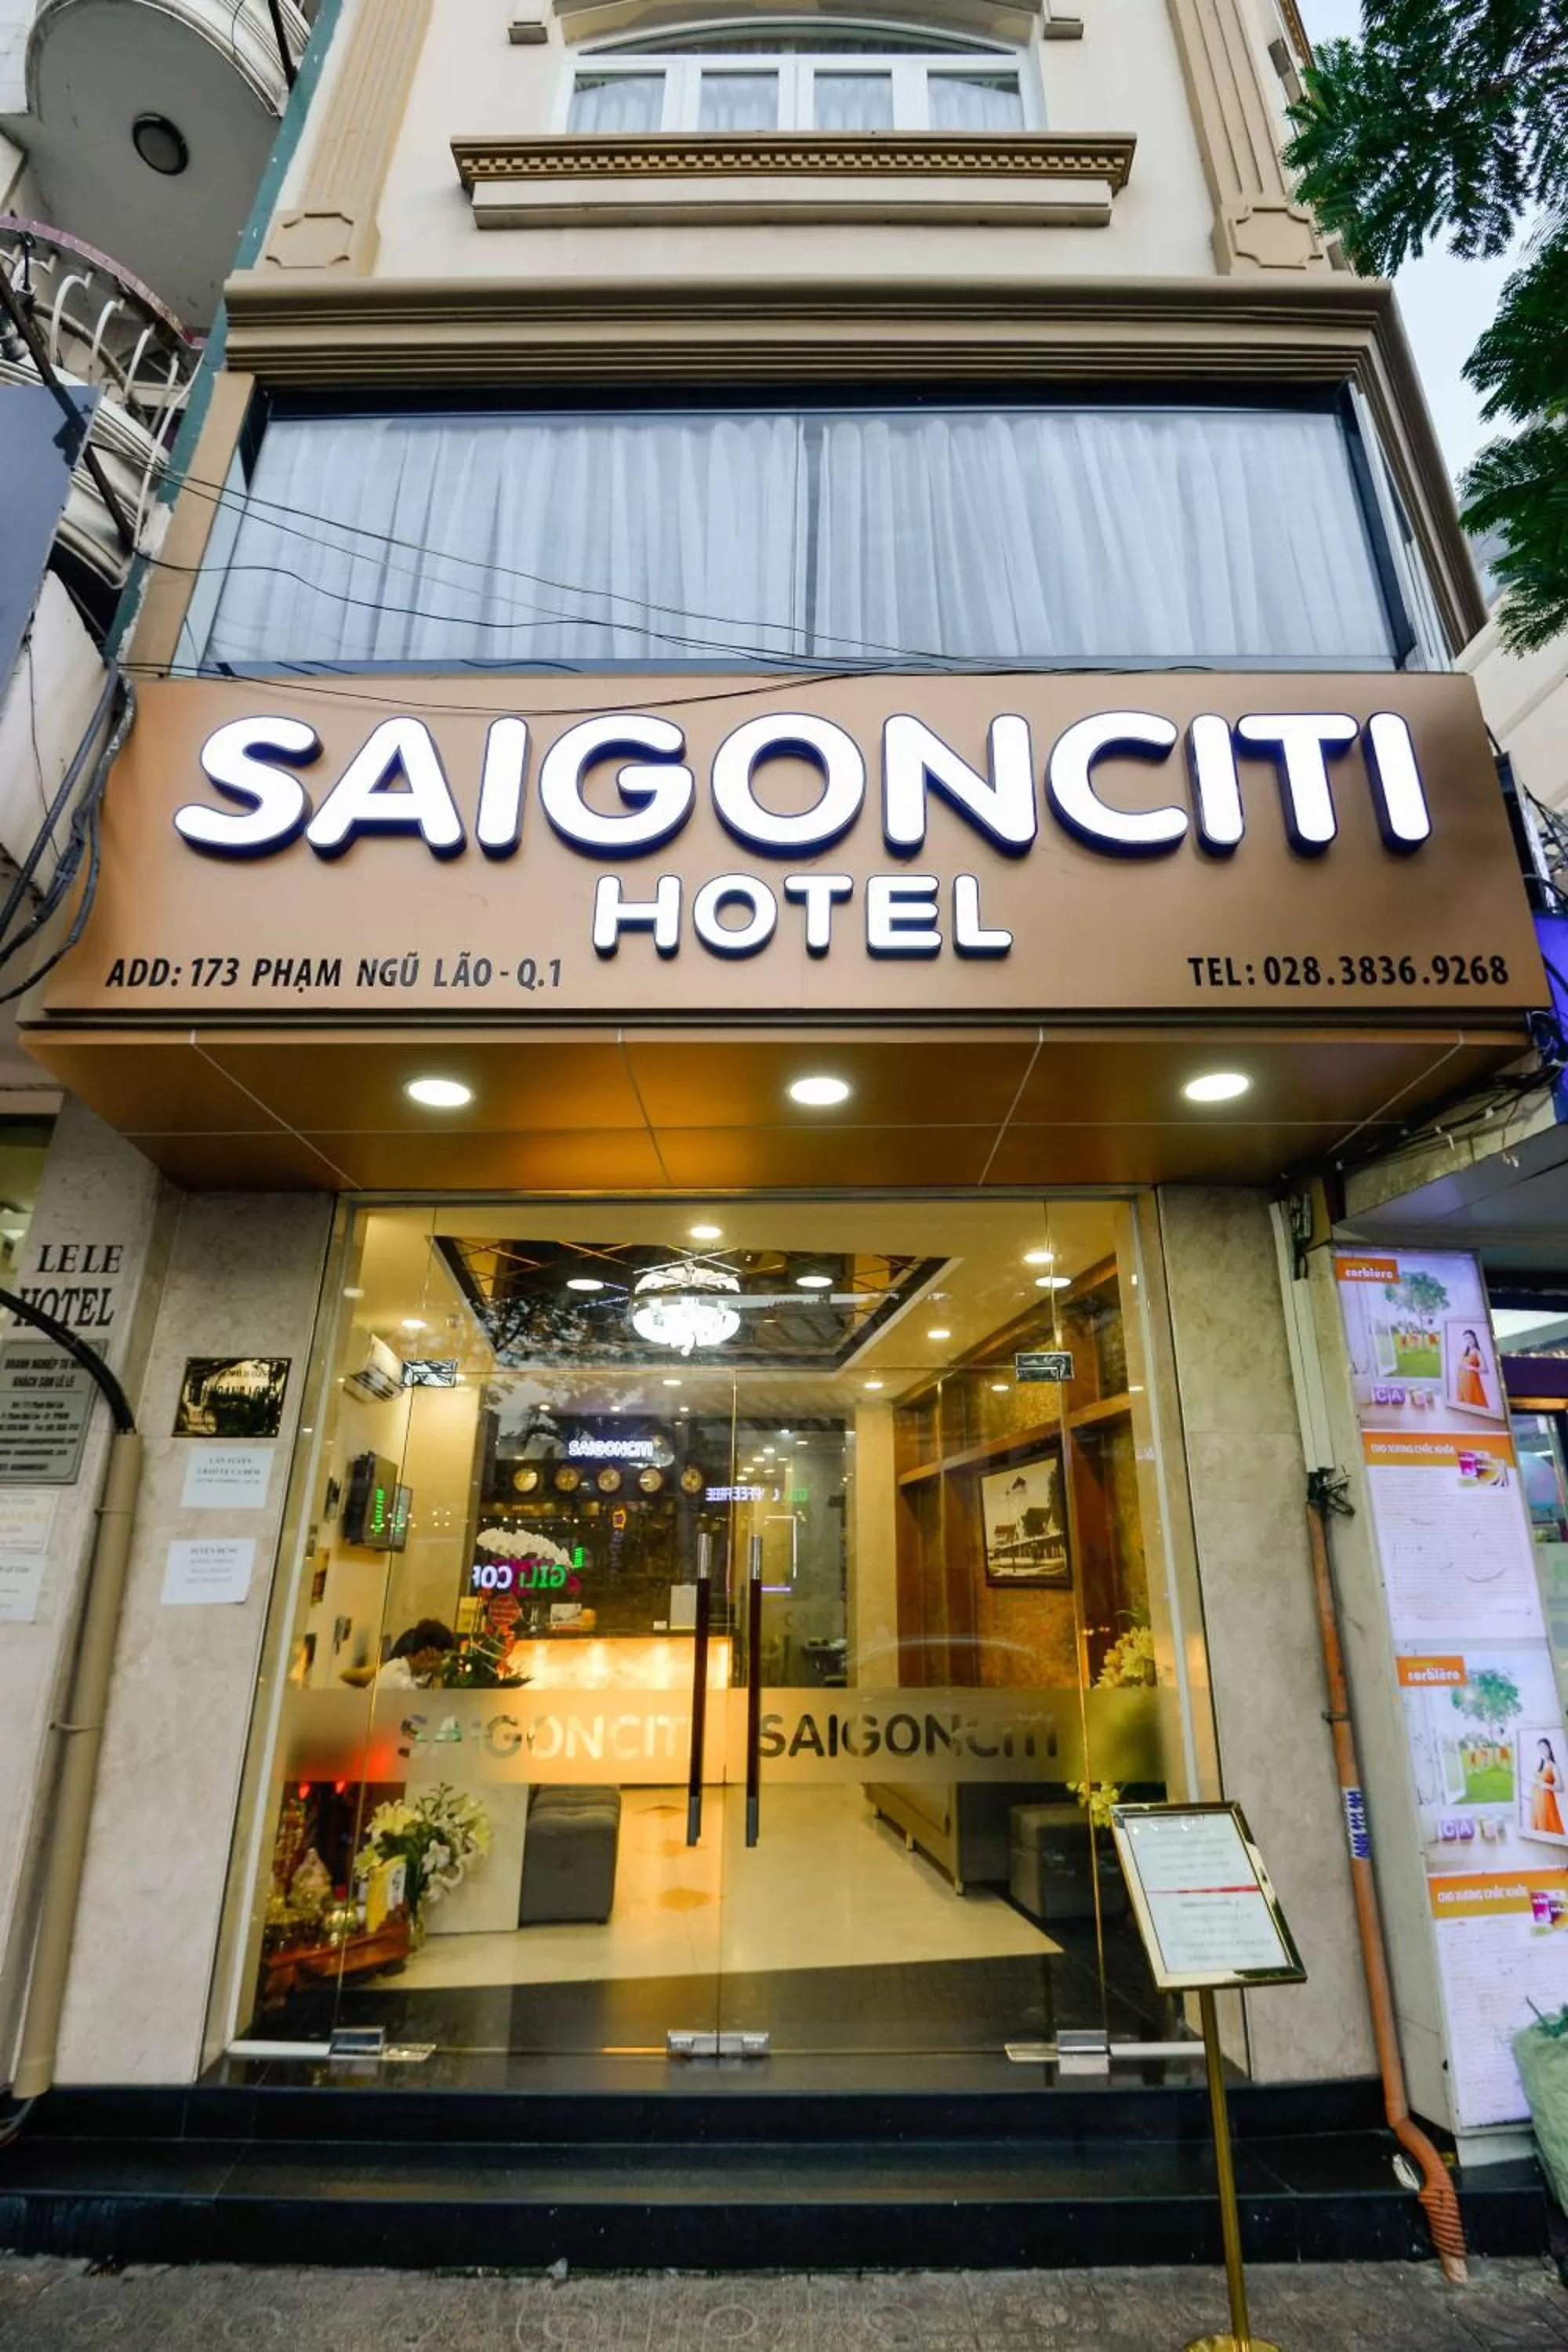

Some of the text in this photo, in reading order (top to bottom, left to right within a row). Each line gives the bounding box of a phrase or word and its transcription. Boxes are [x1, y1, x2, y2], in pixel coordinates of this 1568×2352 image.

[173, 710, 1432, 858] SAIGONCITI
[592, 873, 1014, 959] HOTEL
[105, 958, 181, 987] ADD:
[190, 958, 239, 986] 173
[252, 958, 341, 993] PHẠM
[356, 951, 420, 986] NGŨ
[433, 951, 492, 987] LÃO
[517, 958, 562, 990] Q.1
[1187, 955, 1509, 986] TEL: 028.3836.9268
[13, 1287, 114, 1327] HOTEL
